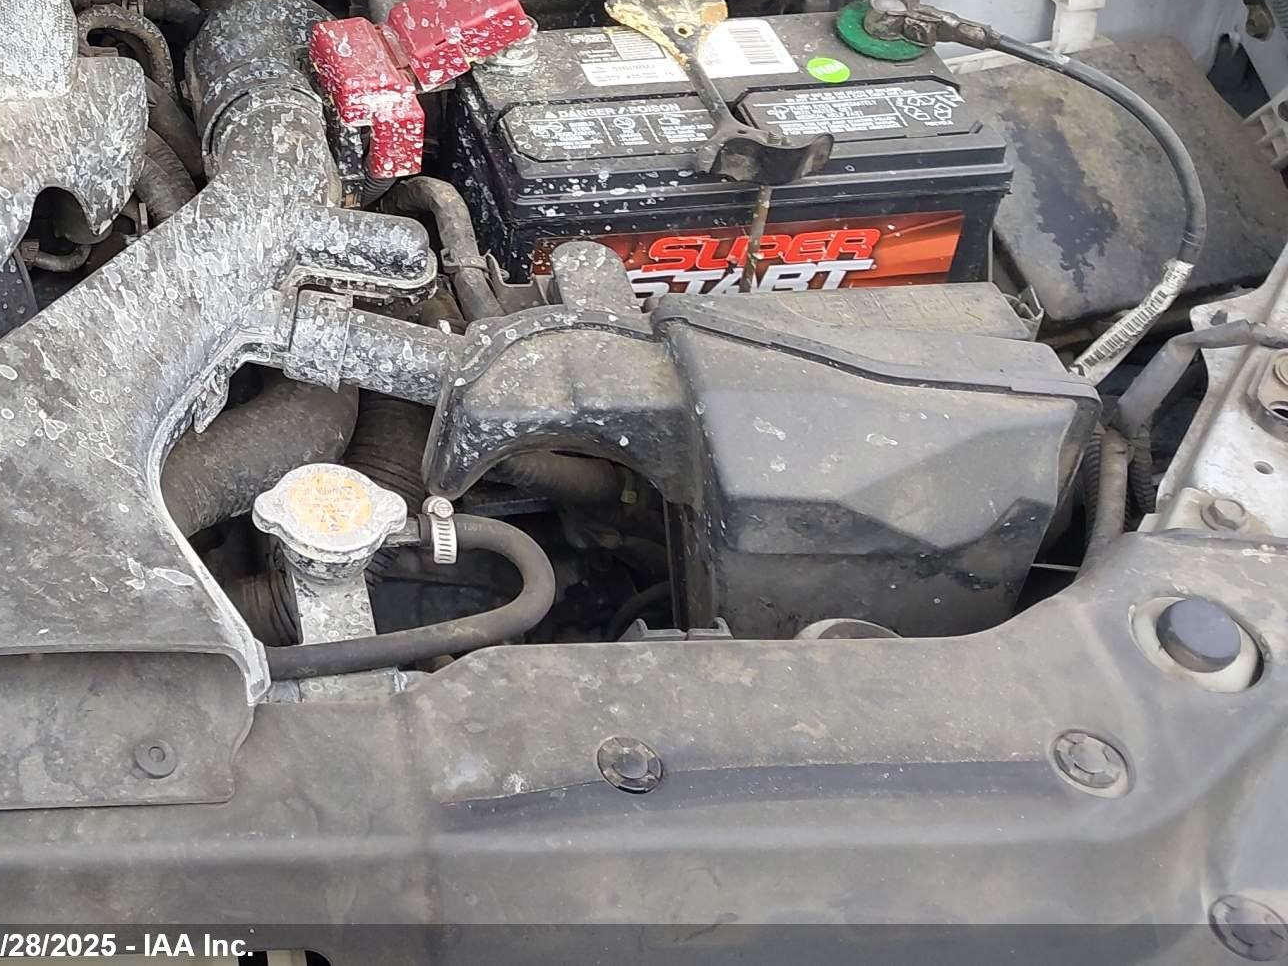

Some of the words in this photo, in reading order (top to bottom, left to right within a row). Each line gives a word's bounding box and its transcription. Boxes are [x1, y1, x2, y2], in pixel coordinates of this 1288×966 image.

[557, 107, 616, 119] DANGER
[629, 103, 680, 114] POISON
[641, 228, 881, 273] SUPER
